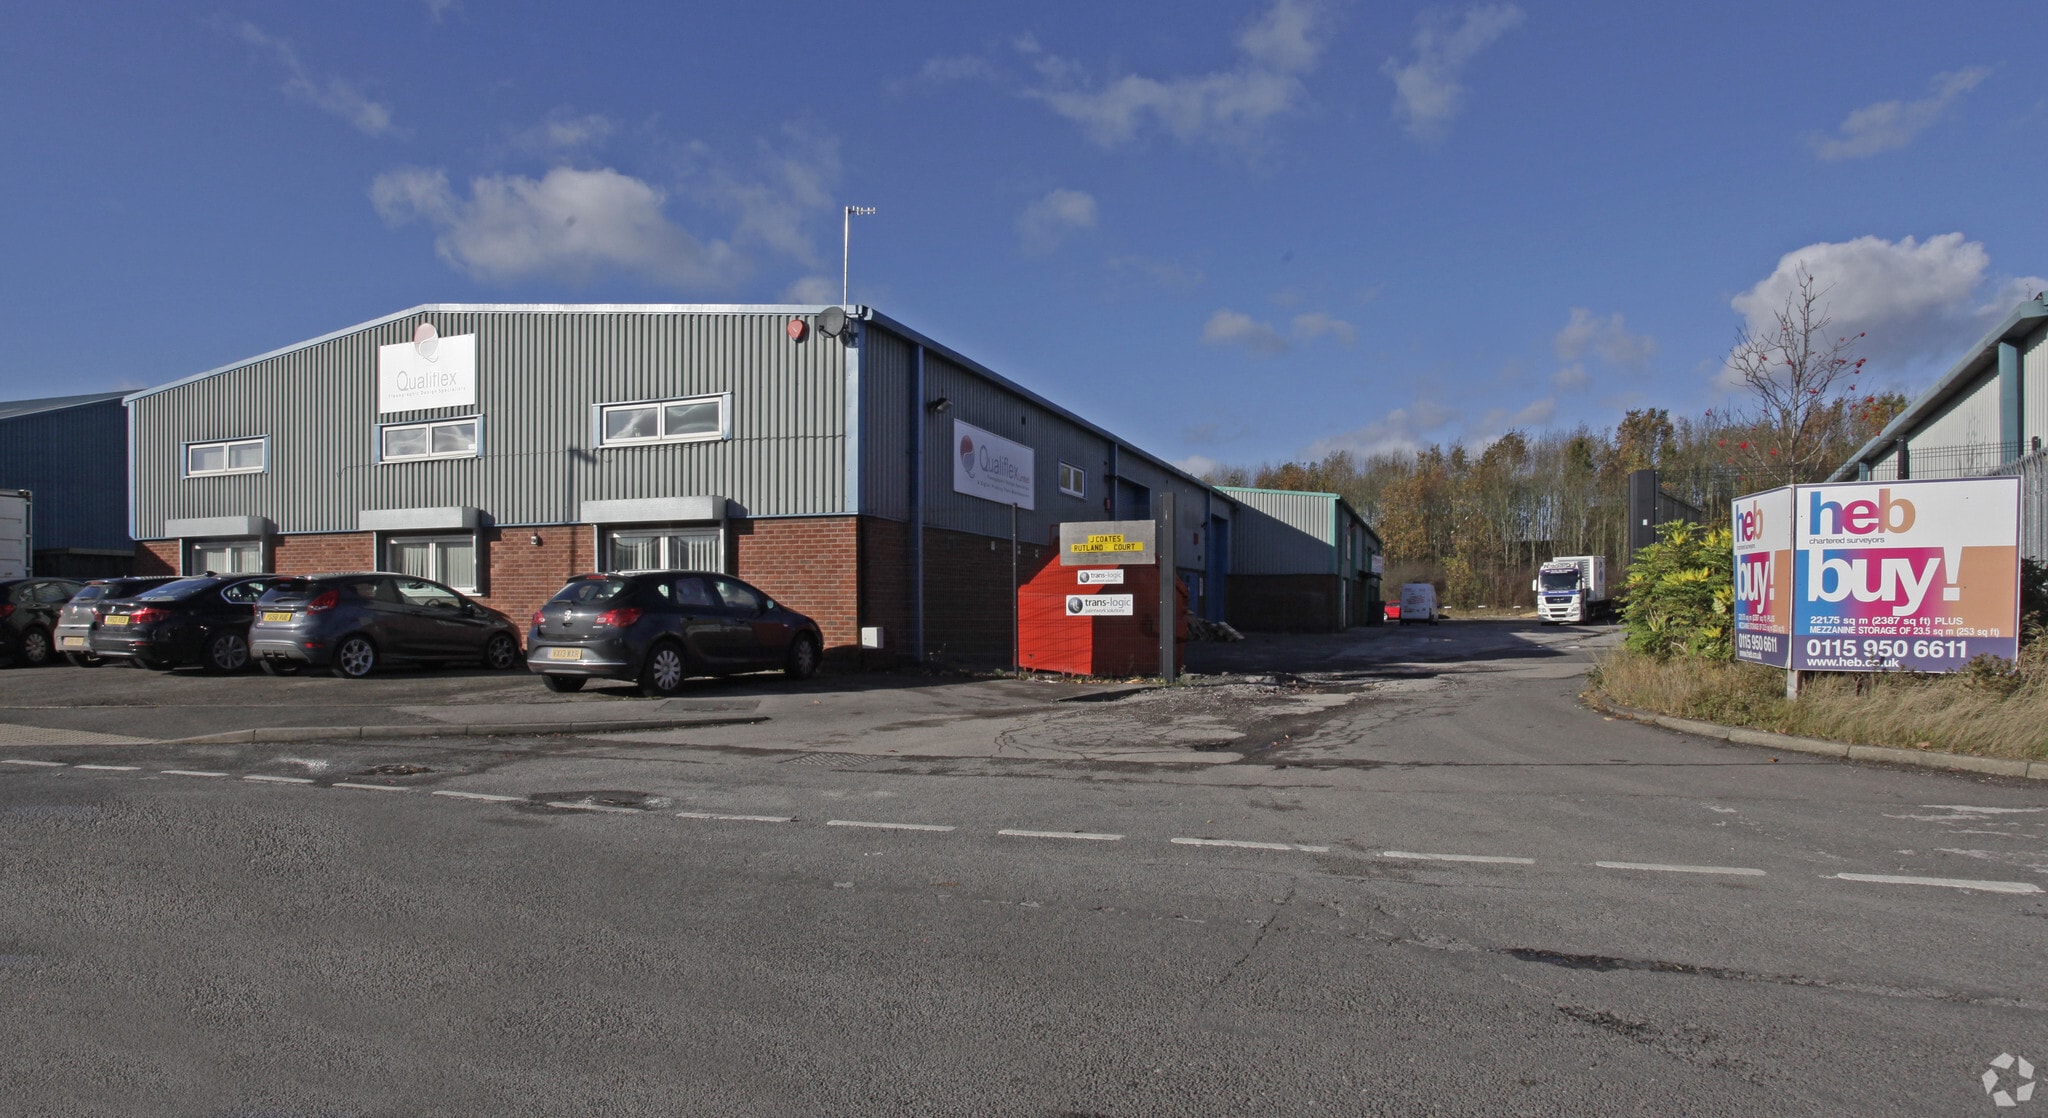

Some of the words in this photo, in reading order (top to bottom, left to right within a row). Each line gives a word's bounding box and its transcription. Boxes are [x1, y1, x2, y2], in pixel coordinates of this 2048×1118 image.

[396, 370, 457, 392] Qualiflex
[979, 444, 1019, 480] Qualiflex
[1736, 500, 1764, 542] heb
[1809, 488, 1916, 536] heb
[1073, 544, 1104, 552] RUTLAND
[1113, 543, 1136, 551] COURT
[1809, 537, 1845, 545] chartered
[1846, 536, 1885, 544] surveyors
[1090, 571, 1122, 580] trans-logic
[1736, 551, 1776, 614] buy!
[1807, 547, 1963, 617] buy!
[1085, 597, 1131, 608] trans-logic
[1810, 616, 1840, 624] 221.75
[1843, 618, 1856, 626] sq
[1871, 616, 1900, 626] (2387
[1903, 618, 1916, 626] sq
[1919, 617, 1931, 626] ft)
[1934, 617, 1964, 625] PLUS
[1809, 626, 1856, 634] MEZZANINE
[1858, 626, 1897, 634] STORAGE
[1899, 627, 1912, 635] OF
[1913, 627, 1931, 635] 23.5
[1932, 628, 1944, 636] sq
[1956, 627, 1975, 636] (253
[1976, 628, 1988, 637] sq
[1990, 628, 2000, 637] ft)
[1738, 633, 1751, 649] 0115
[1751, 634, 1764, 651] 950
[1763, 636, 1777, 653] 6611
[1806, 639, 1857, 657] 0115
[1863, 639, 1908, 657] 950
[1913, 640, 1967, 658] 6611
